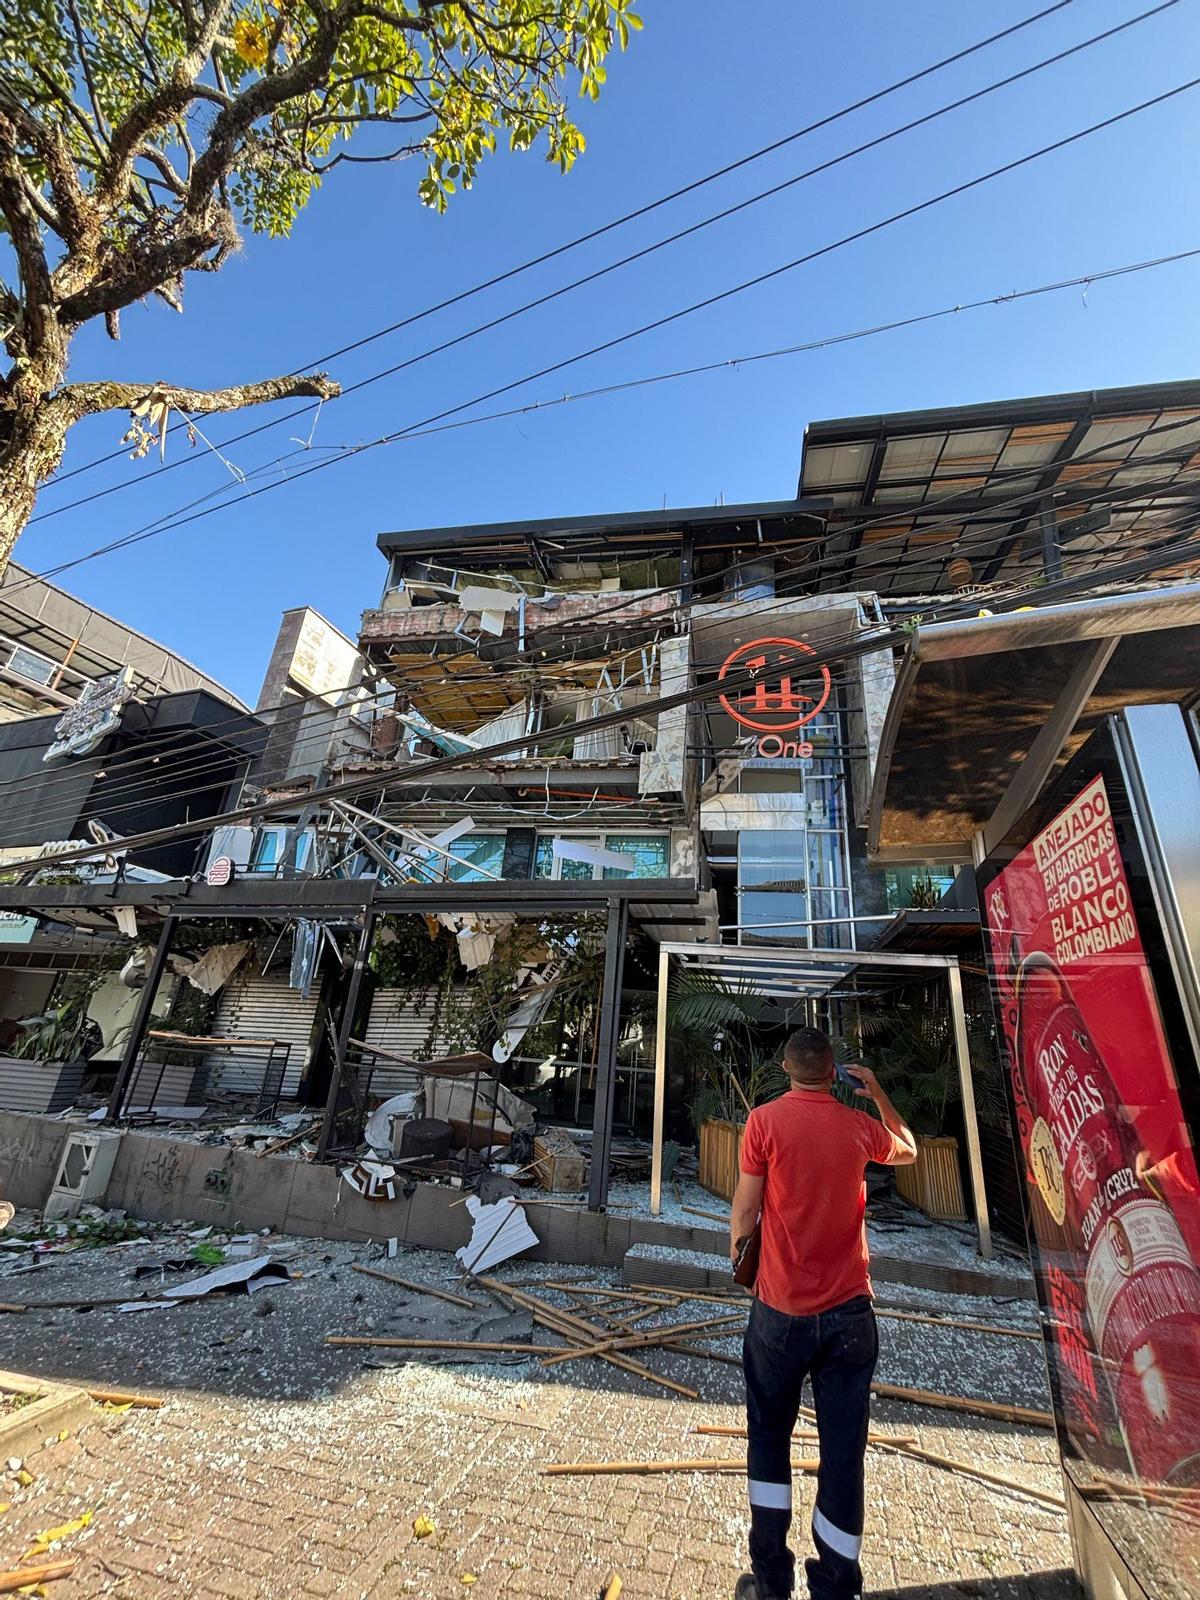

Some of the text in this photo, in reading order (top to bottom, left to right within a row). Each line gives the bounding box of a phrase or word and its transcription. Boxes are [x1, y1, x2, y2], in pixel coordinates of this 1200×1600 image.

[758, 733, 814, 758] One
[1038, 791, 1106, 866] AÑEJADO
[1044, 820, 1114, 892] EN BARRICAS
[1047, 850, 1121, 913] DE ROBLE
[1051, 880, 1128, 944] BLANCO
[1055, 916, 1136, 966] COLOMBIANO
[1039, 1033, 1069, 1096] RON
[1048, 1077, 1069, 1116] VIEJO
[1064, 1063, 1078, 1087] DE
[1050, 1074, 1105, 1171] CALDAS
[1081, 1196, 1102, 1251] JUAN
[1106, 1167, 1140, 1201] CRUZ
